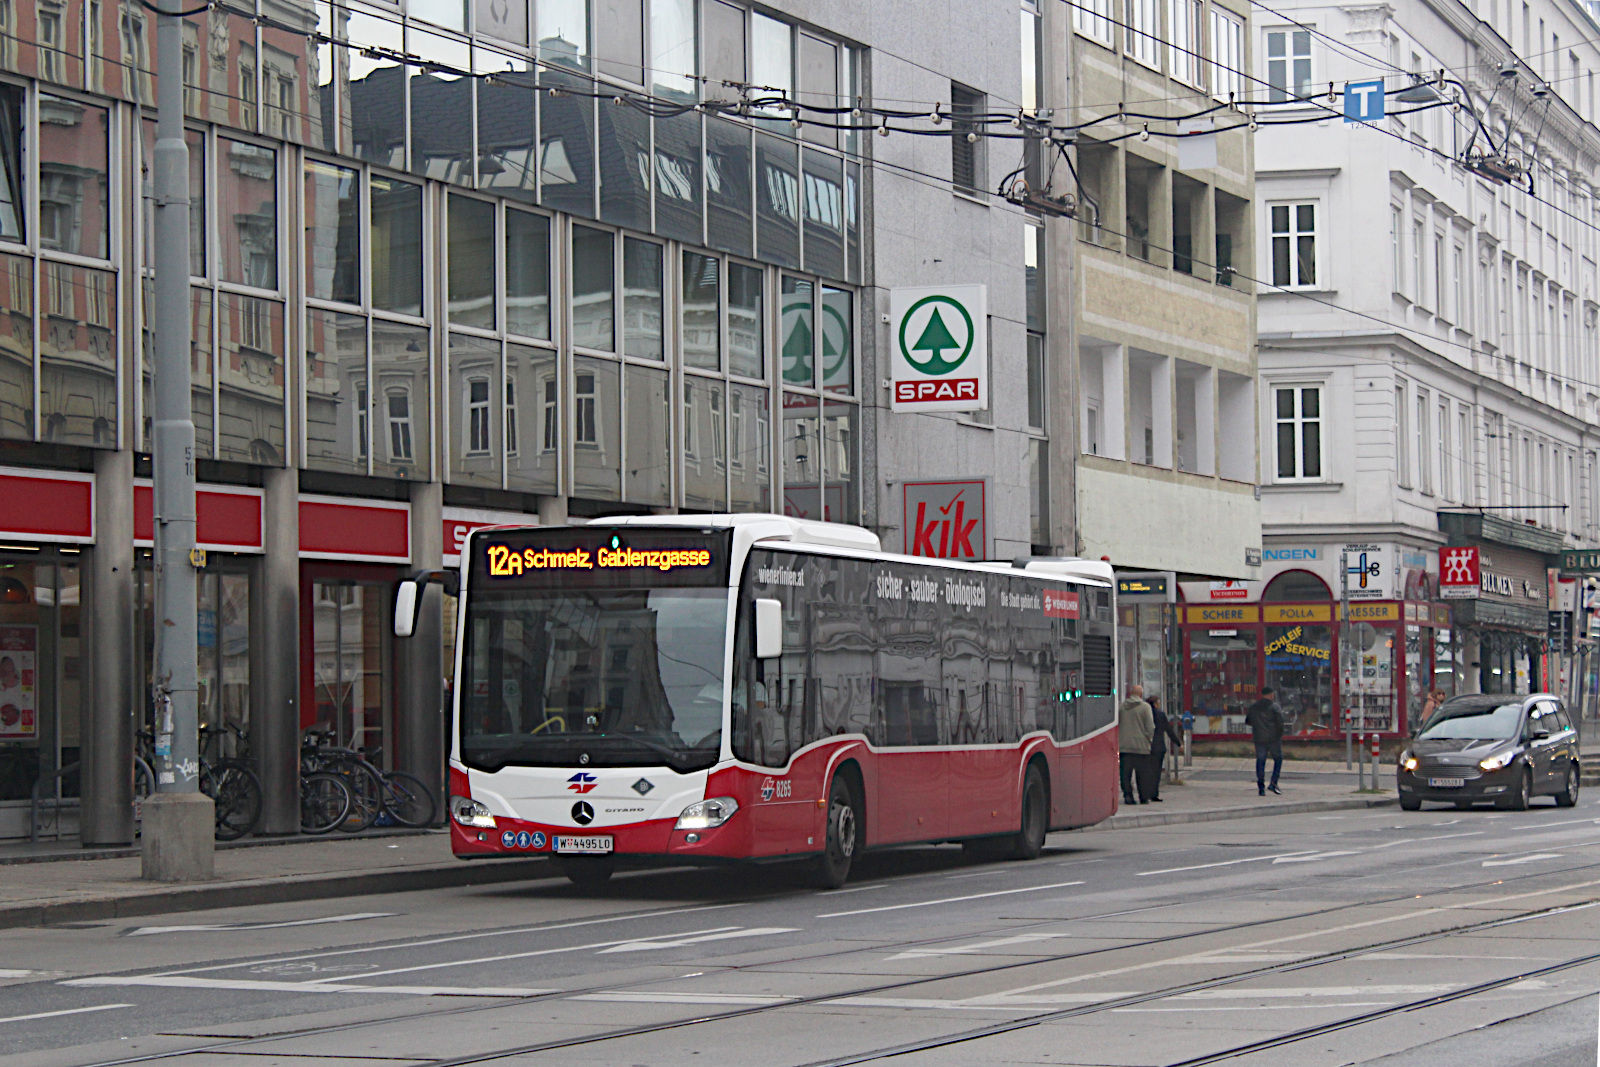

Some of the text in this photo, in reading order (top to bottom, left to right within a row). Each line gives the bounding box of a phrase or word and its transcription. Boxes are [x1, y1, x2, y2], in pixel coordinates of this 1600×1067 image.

[1351, 86, 1377, 117] T
[898, 381, 976, 399] SPAR
[487, 545, 710, 576] 12A Schmelz, Gablenzgasse
[758, 564, 804, 587] wienerlinien.at
[1481, 571, 1514, 597] BLUMEN
[877, 573, 902, 600] sicher
[911, 578, 938, 604] sauber
[945, 579, 986, 612] ökologisch
[1009, 592, 1020, 608] Stadt
[1202, 610, 1243, 620] SCHERE
[1280, 609, 1314, 618] POLLA
[1264, 626, 1302, 655] SCHLEIF
[1285, 643, 1330, 660] SERVICE
[776, 779, 792, 798] 8265
